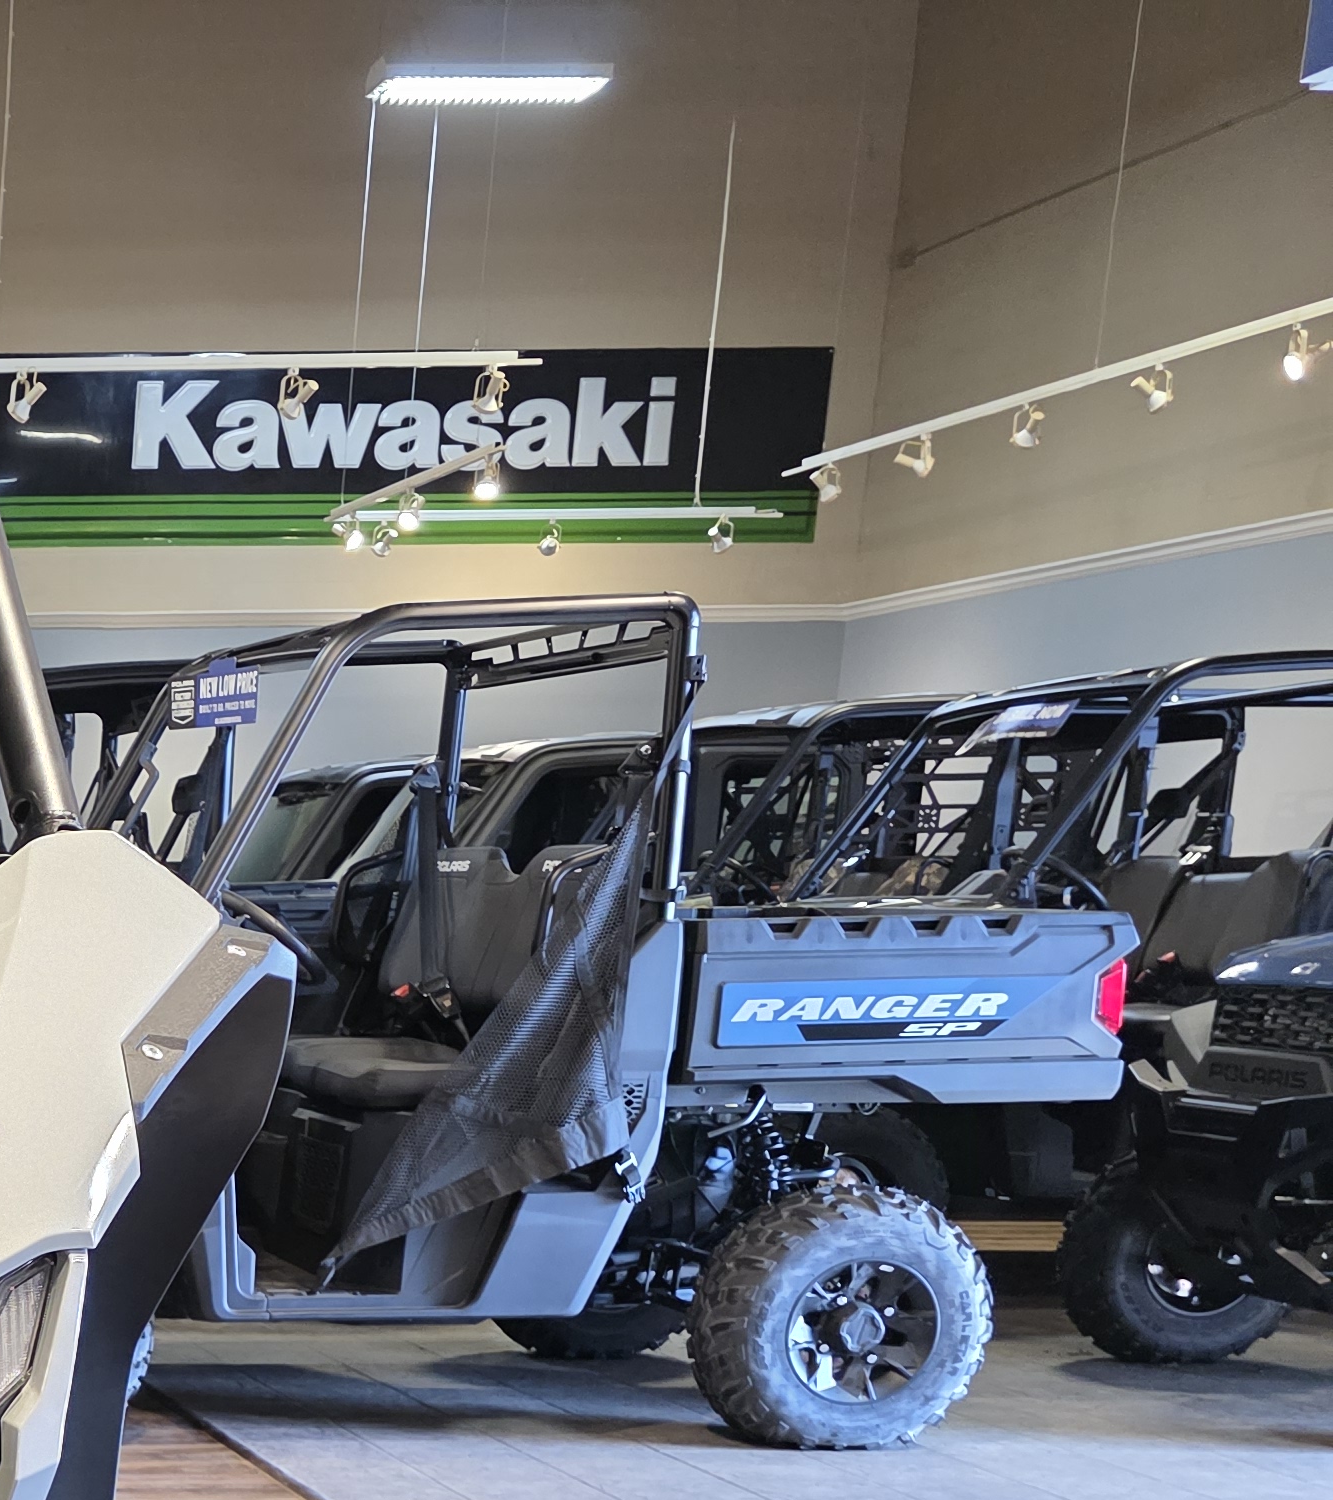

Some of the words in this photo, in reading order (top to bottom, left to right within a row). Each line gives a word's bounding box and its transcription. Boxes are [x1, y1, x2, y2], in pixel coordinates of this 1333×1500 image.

[131, 376, 677, 472] Kawasaki
[199, 676, 218, 699] NEW
[218, 674, 236, 697] LOW
[236, 670, 258, 695] PRICE
[730, 992, 1009, 1023] RANGER
[898, 1021, 982, 1037] SP
[1208, 1062, 1308, 1089] POLARIS
